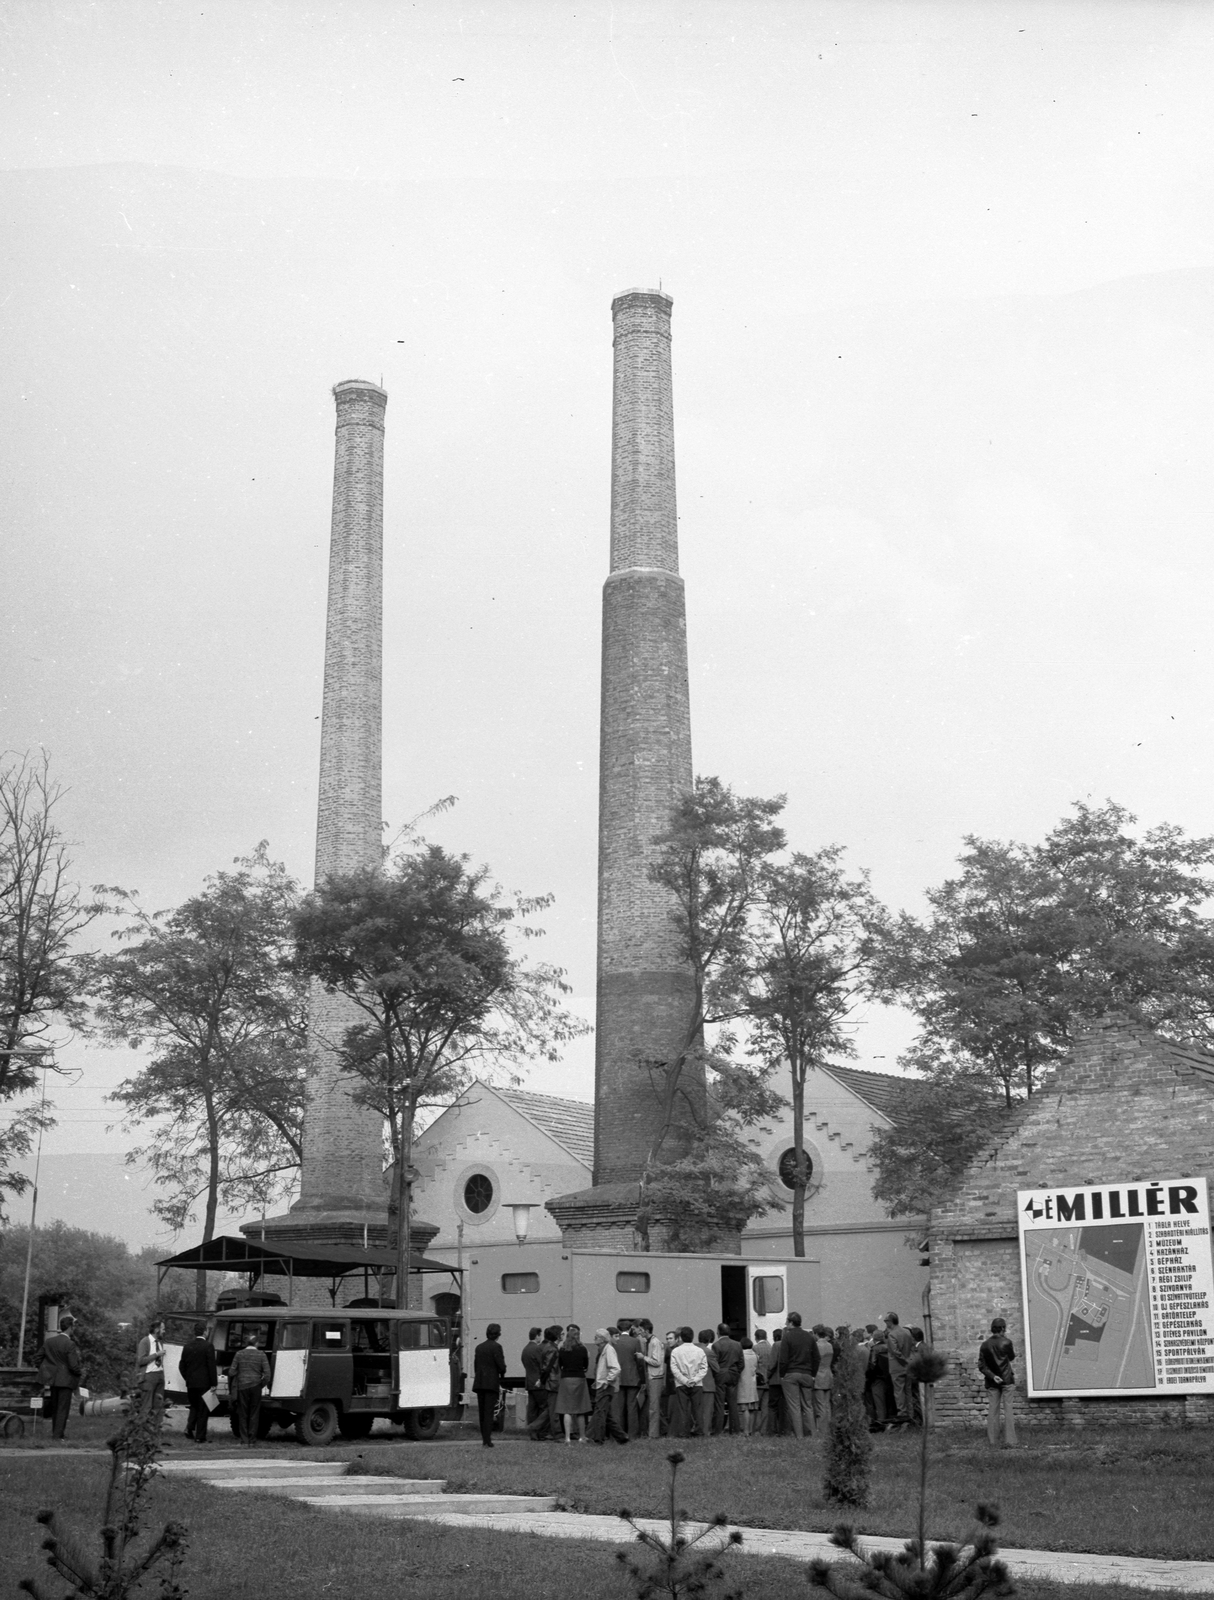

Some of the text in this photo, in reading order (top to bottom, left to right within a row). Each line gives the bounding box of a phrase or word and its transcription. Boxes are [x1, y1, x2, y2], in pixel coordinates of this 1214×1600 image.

[1056, 1182, 1199, 1222] MILLÉR
[1155, 1221, 1171, 1229] TÁBLA
[1173, 1220, 1190, 1228] HELYE
[1185, 1227, 1209, 1236] KIÁLLÍTÁS
[1156, 1238, 1182, 1247] MÚZEUM
[1157, 1247, 1189, 1256] KAZÁNHÁZ
[1157, 1256, 1183, 1265] GÉPHÁZ
[1158, 1264, 1196, 1274] SZÉNRAKTÁR
[1159, 1275, 1172, 1283] RÉGI
[1174, 1274, 1192, 1282] ZSILIP
[1152, 1285, 1156, 1293] 8
[1160, 1293, 1166, 1302] ÚJ
[1161, 1302, 1167, 1310] ÚJ
[1169, 1301, 1209, 1310] GÉPÉSZLAKÁS
[1162, 1319, 1203, 1329] GÉPÉSZLAKÁS
[1183, 1329, 1207, 1337] PAVILON
[1164, 1347, 1206, 1356] SPORTPÁLYÁK
